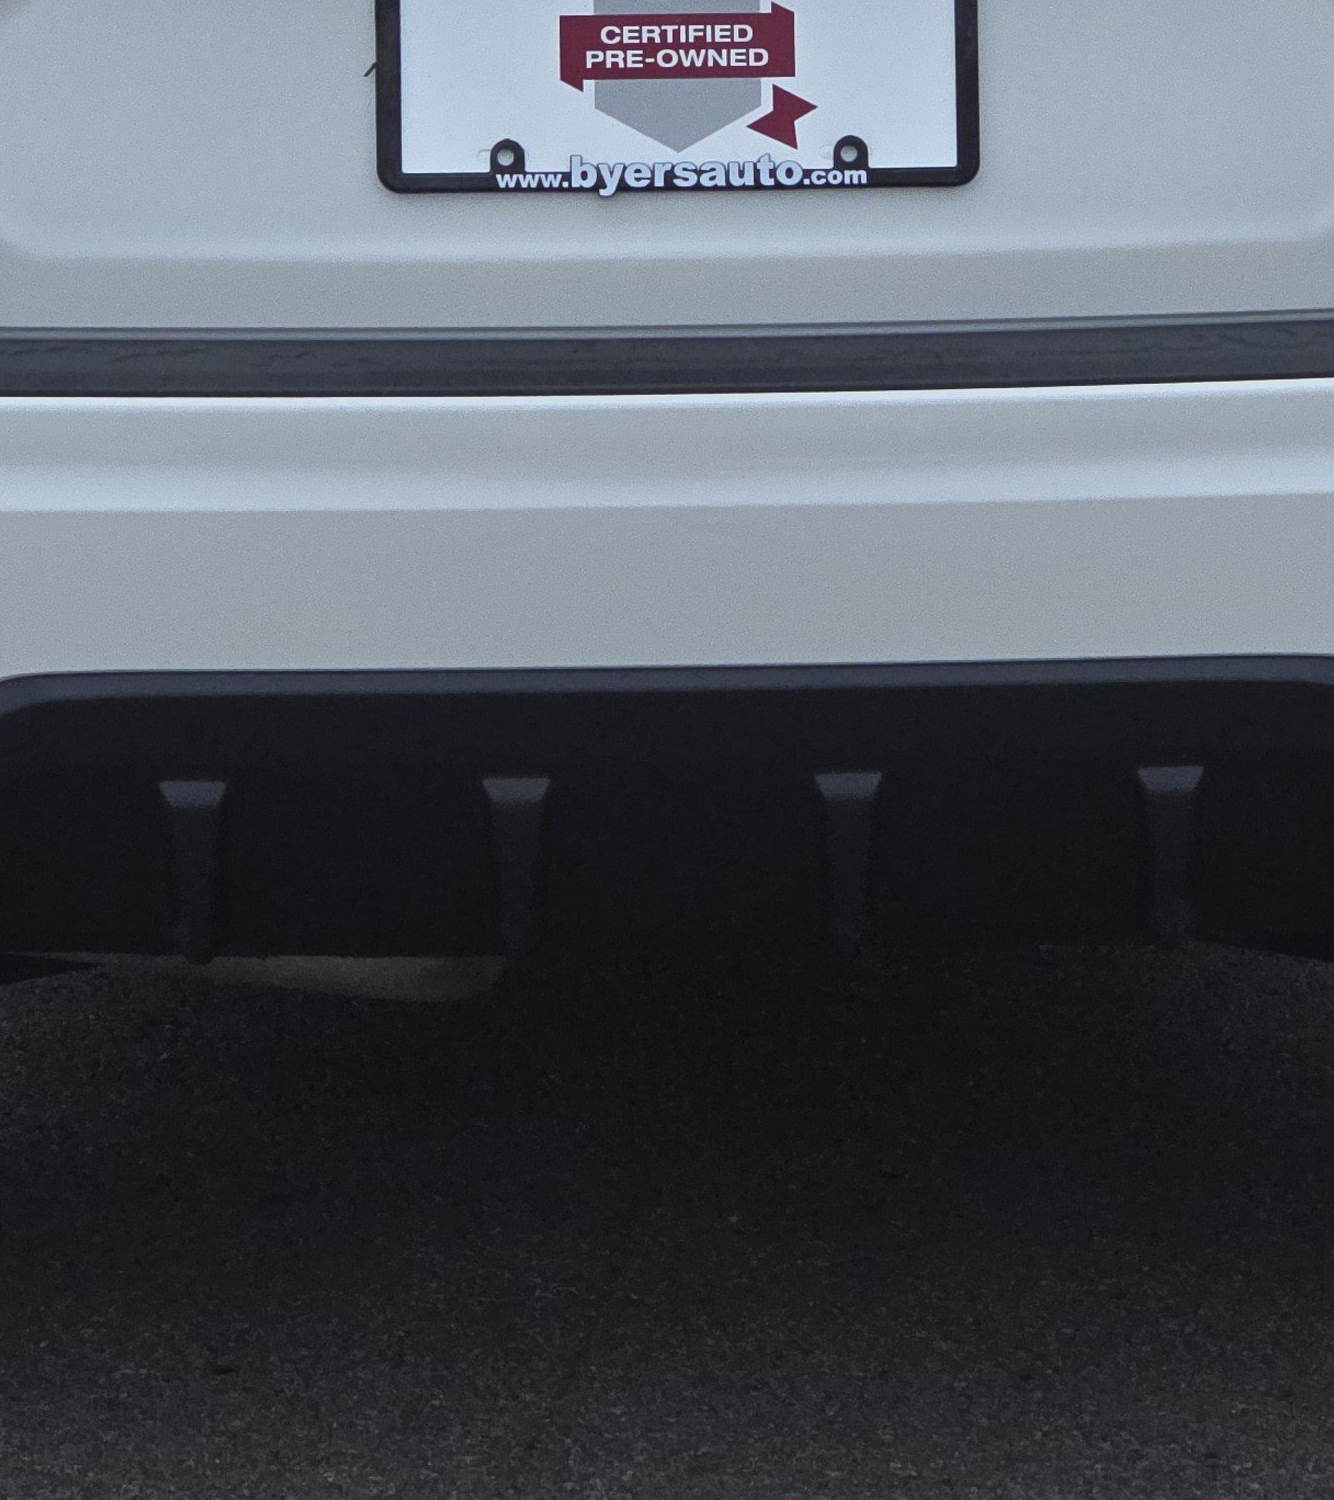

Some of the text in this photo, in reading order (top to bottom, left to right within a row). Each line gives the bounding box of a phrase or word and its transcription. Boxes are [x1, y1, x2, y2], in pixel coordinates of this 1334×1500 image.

[600, 24, 754, 45] CERTIFIED
[585, 48, 769, 69] PRE-OWNED
[495, 152, 868, 198] www.byersauto.com
